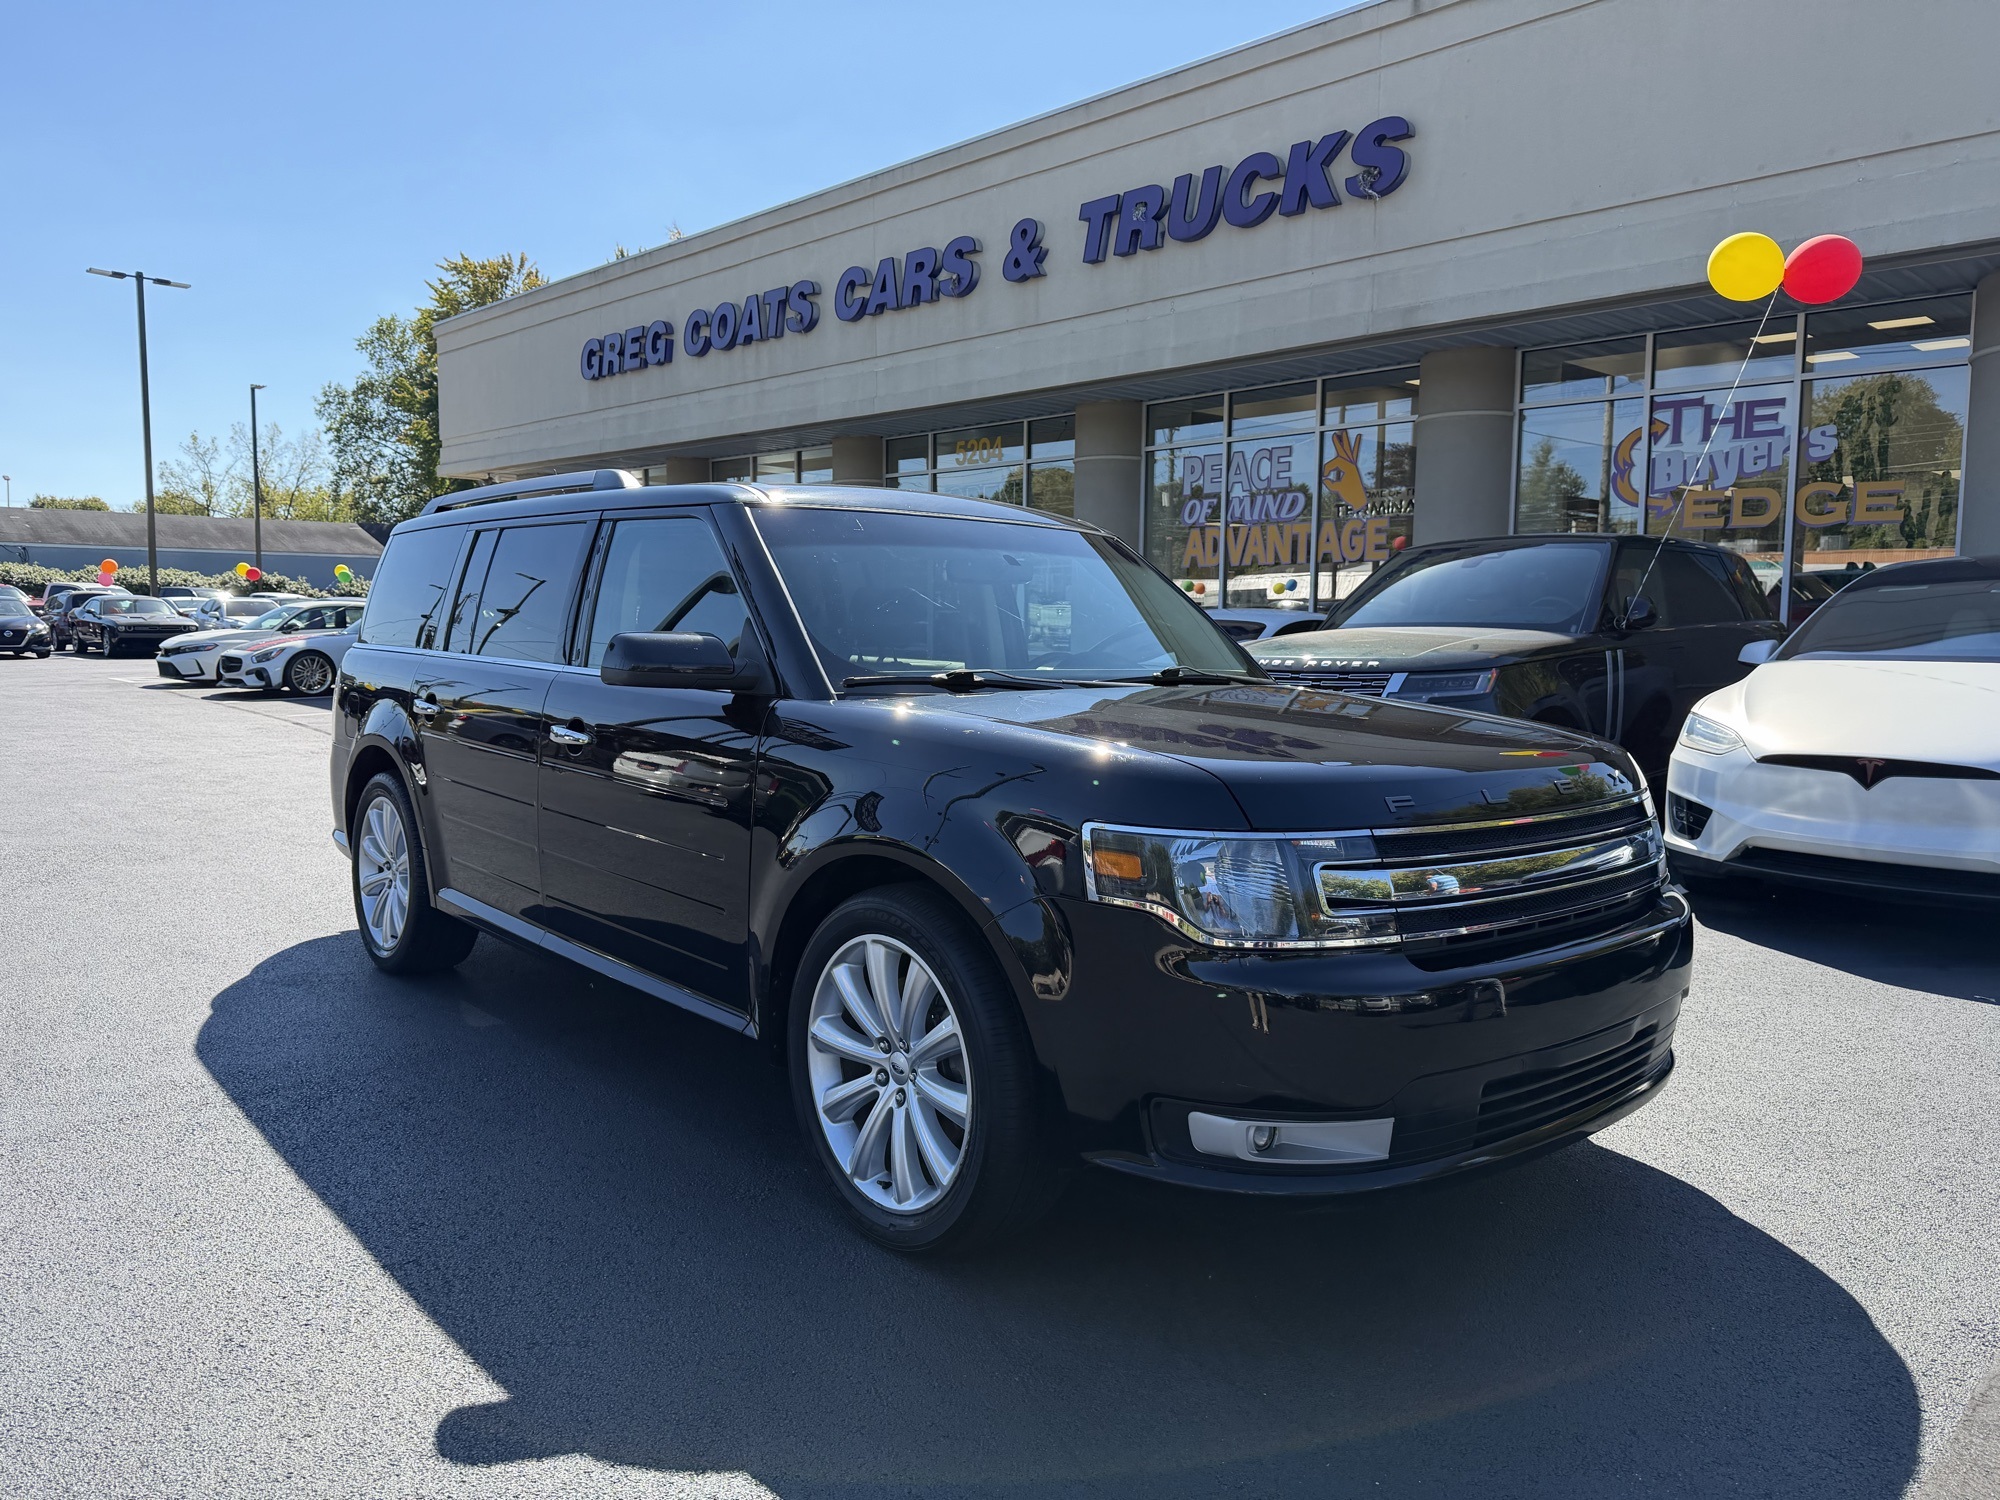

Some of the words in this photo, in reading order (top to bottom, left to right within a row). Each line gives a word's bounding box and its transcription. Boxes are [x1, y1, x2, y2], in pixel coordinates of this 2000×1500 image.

[581, 320, 674, 380] GREG
[684, 280, 821, 357] COATS
[834, 235, 983, 322] CARS
[1003, 218, 1049, 283] &
[1079, 116, 1415, 264] TRUCKS
[1652, 396, 1787, 447] THE
[955, 435, 1003, 466] 5204
[1183, 445, 1293, 496] PEACE
[1181, 498, 1218, 526] OF
[1227, 491, 1306, 525] MIND
[1366, 490, 1385, 498] OME
[1681, 479, 1905, 529] EDGE
[1182, 517, 1391, 568] ADVANTAGE
[1258, 659, 1294, 667] NGE
[1303, 659, 1380, 668] ROVER
[1384, 769, 1626, 813] FLEX
